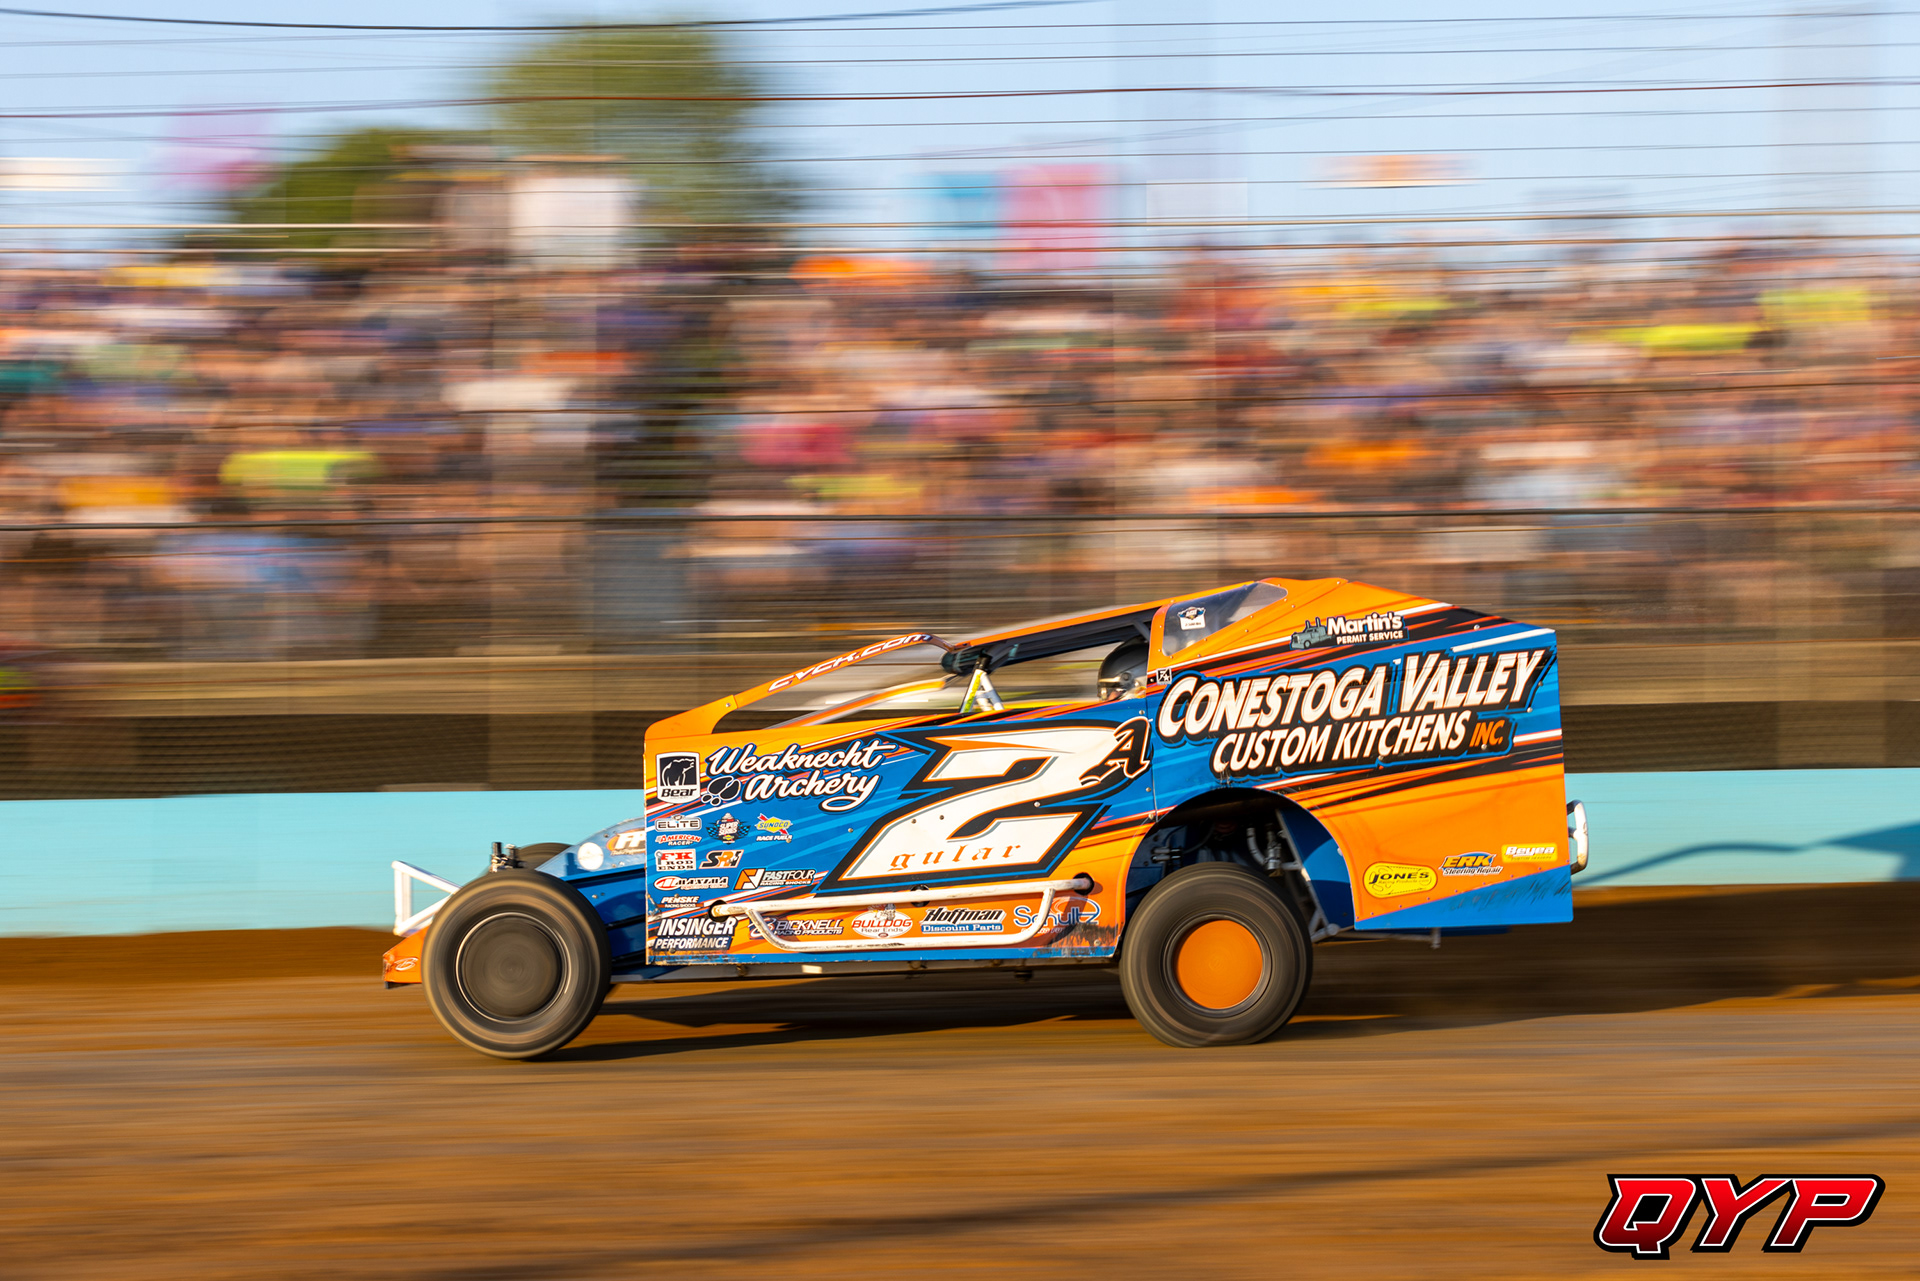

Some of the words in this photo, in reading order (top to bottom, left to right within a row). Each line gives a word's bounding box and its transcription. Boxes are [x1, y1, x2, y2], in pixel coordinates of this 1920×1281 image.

[1327, 612, 1403, 635] Martin's
[1336, 633, 1367, 645] PERMIT
[1369, 630, 1404, 642] SERVICE
[1158, 667, 1383, 738] CONESTOGA
[1394, 650, 1545, 714] VALLEY
[1212, 725, 1334, 773] CUSTOM
[1332, 711, 1472, 761] KITCHENS
[1469, 719, 1504, 748] INC.
[707, 740, 897, 776] Weaknecht
[661, 787, 697, 798] Bear
[742, 774, 880, 811] Archery
[759, 821, 789, 829] SUNOCO
[659, 834, 702, 843] AMERICAN
[660, 851, 694, 861] FK
[888, 843, 1021, 871] gular
[1442, 855, 1493, 868] ERK
[762, 869, 816, 881] FASTFOUR
[1444, 867, 1475, 876] Steering
[1477, 866, 1502, 874] Repair
[1369, 870, 1430, 885] JONES
[661, 895, 700, 904] PENSKE
[923, 907, 1003, 925] Hoffman
[657, 916, 737, 937] INSINGER
[776, 919, 843, 930] BICKNELL
[852, 918, 912, 929] BULLDOG
[923, 923, 969, 933] Discount
[973, 923, 1001, 932] Parts
[654, 937, 729, 949] PERFORMANCE
